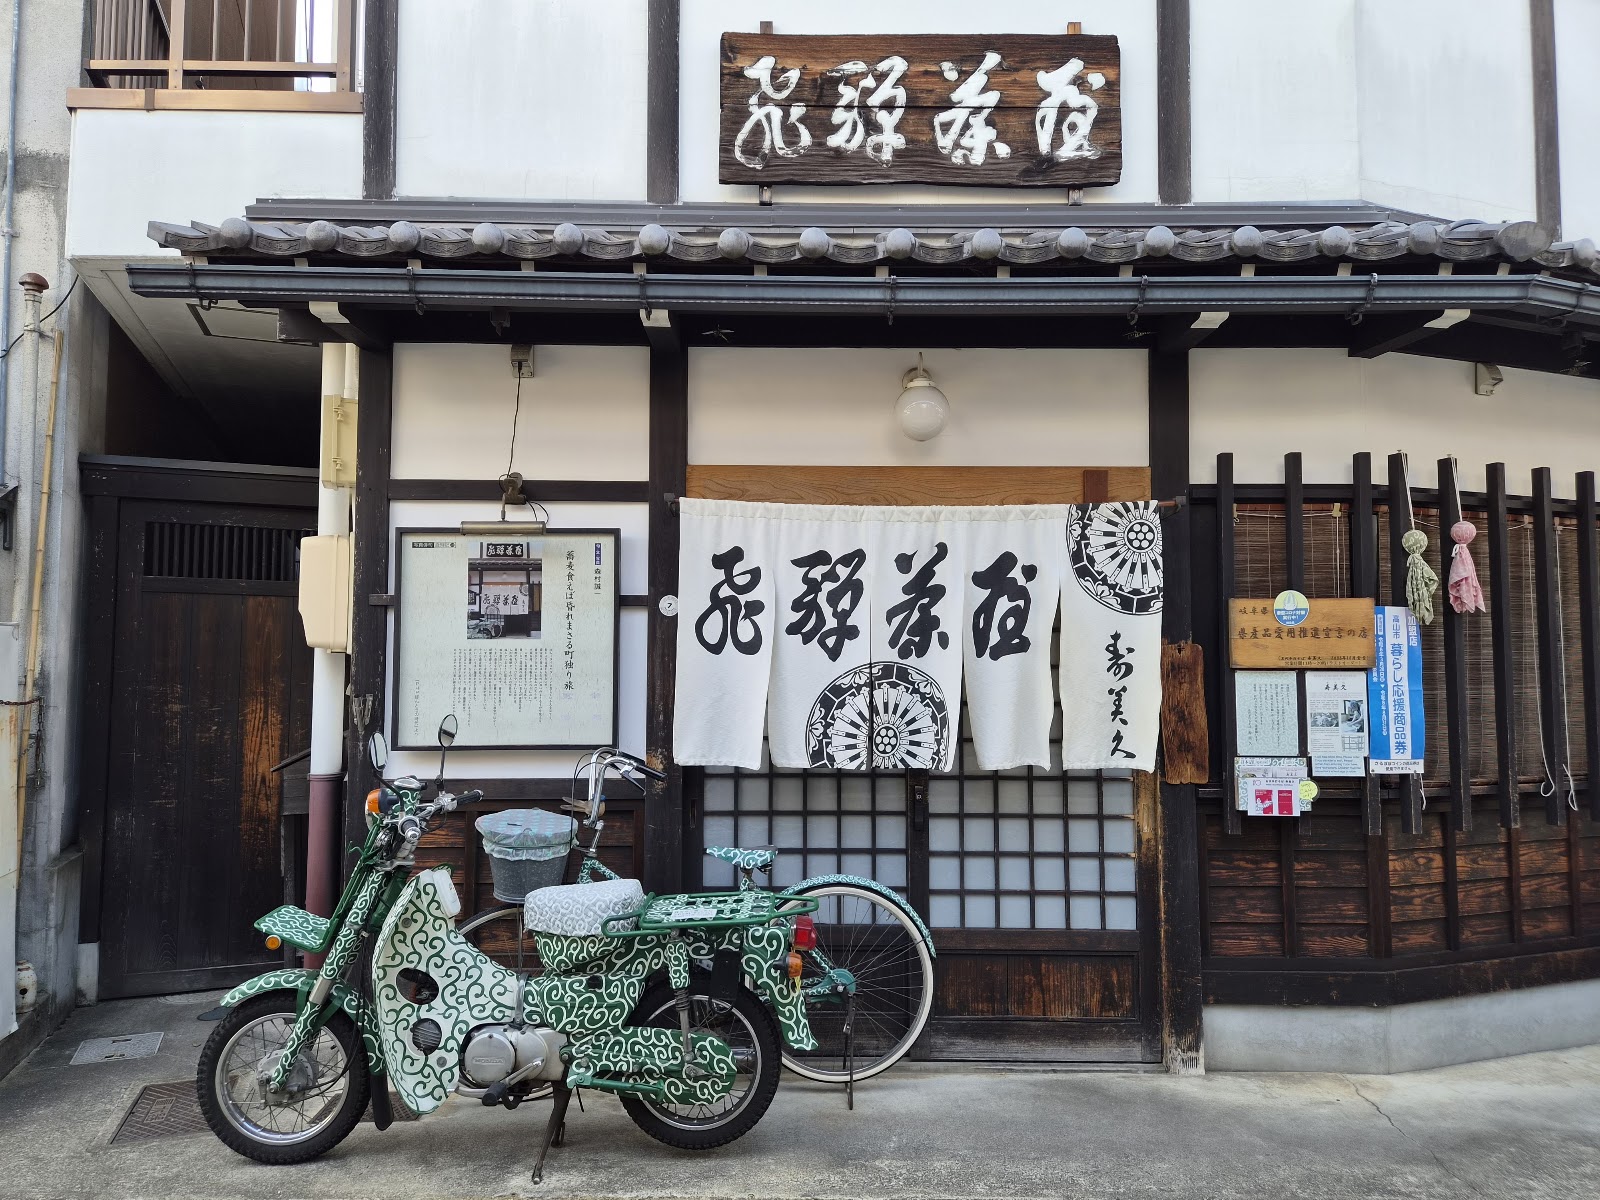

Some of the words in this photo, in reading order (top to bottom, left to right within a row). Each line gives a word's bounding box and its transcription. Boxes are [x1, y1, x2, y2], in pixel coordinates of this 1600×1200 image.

[1393, 615, 1401, 640] 高山市
[1407, 615, 1418, 647] 加盟店
[1390, 643, 1408, 755] 暮らし応援商品券
